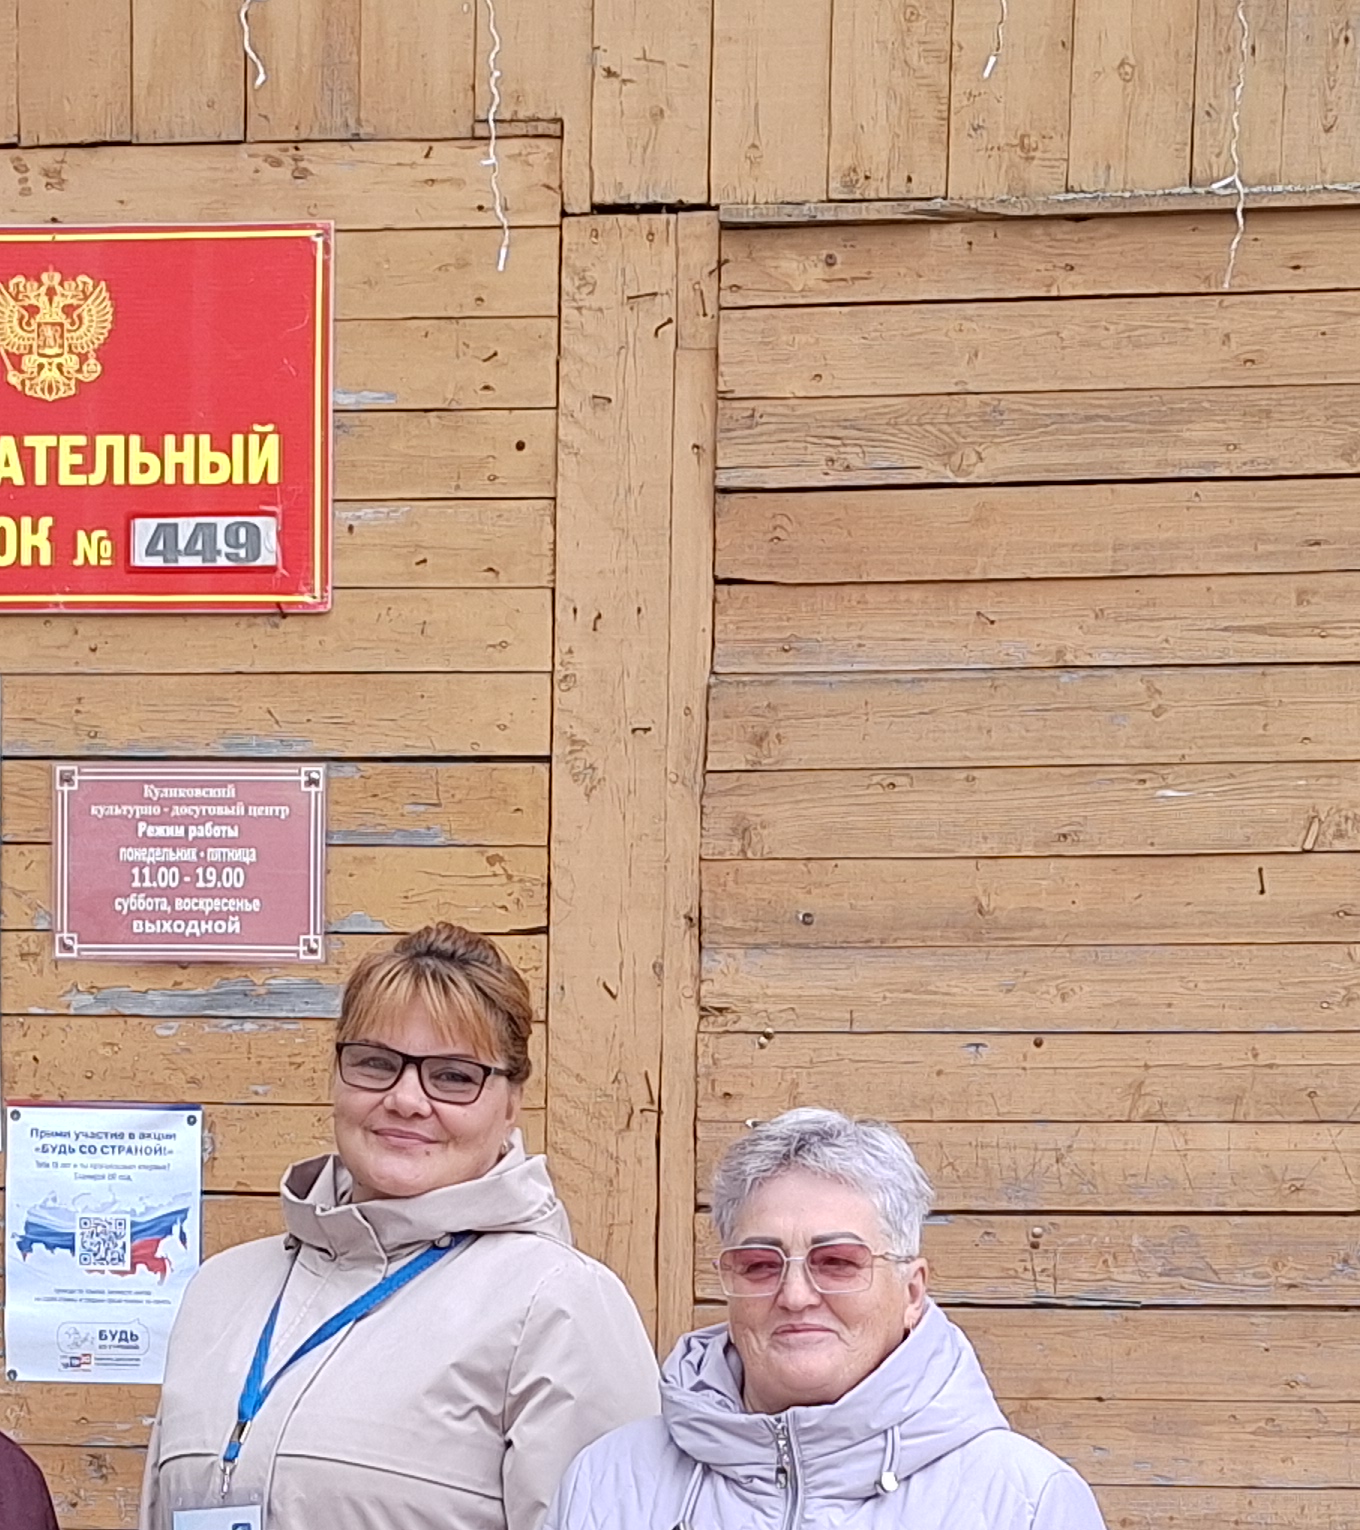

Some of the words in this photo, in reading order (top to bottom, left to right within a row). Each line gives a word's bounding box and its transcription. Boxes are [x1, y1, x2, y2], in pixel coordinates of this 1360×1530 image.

[73, 530, 111, 566] №
[144, 521, 263, 564] 449
[144, 784, 235, 800] Куликовский
[91, 804, 160, 819] культурно
[171, 803, 244, 818] досуговый
[248, 805, 289, 820] центр
[138, 822, 184, 837] Режим
[188, 822, 239, 840] работы
[120, 847, 197, 864] понедельник
[207, 848, 256, 864] пятница
[132, 866, 179, 887] 11.00
[196, 867, 244, 887] 19.00
[115, 894, 171, 914] суббота,
[175, 896, 261, 914] воскресенье
[132, 917, 240, 936] выходной
[31, 1128, 70, 1139] Прими
[74, 1132, 124, 1141] участие
[139, 1132, 176, 1141] акции
[79, 1145, 97, 1154] СО
[99, 1330, 139, 1343] БУДЬ
